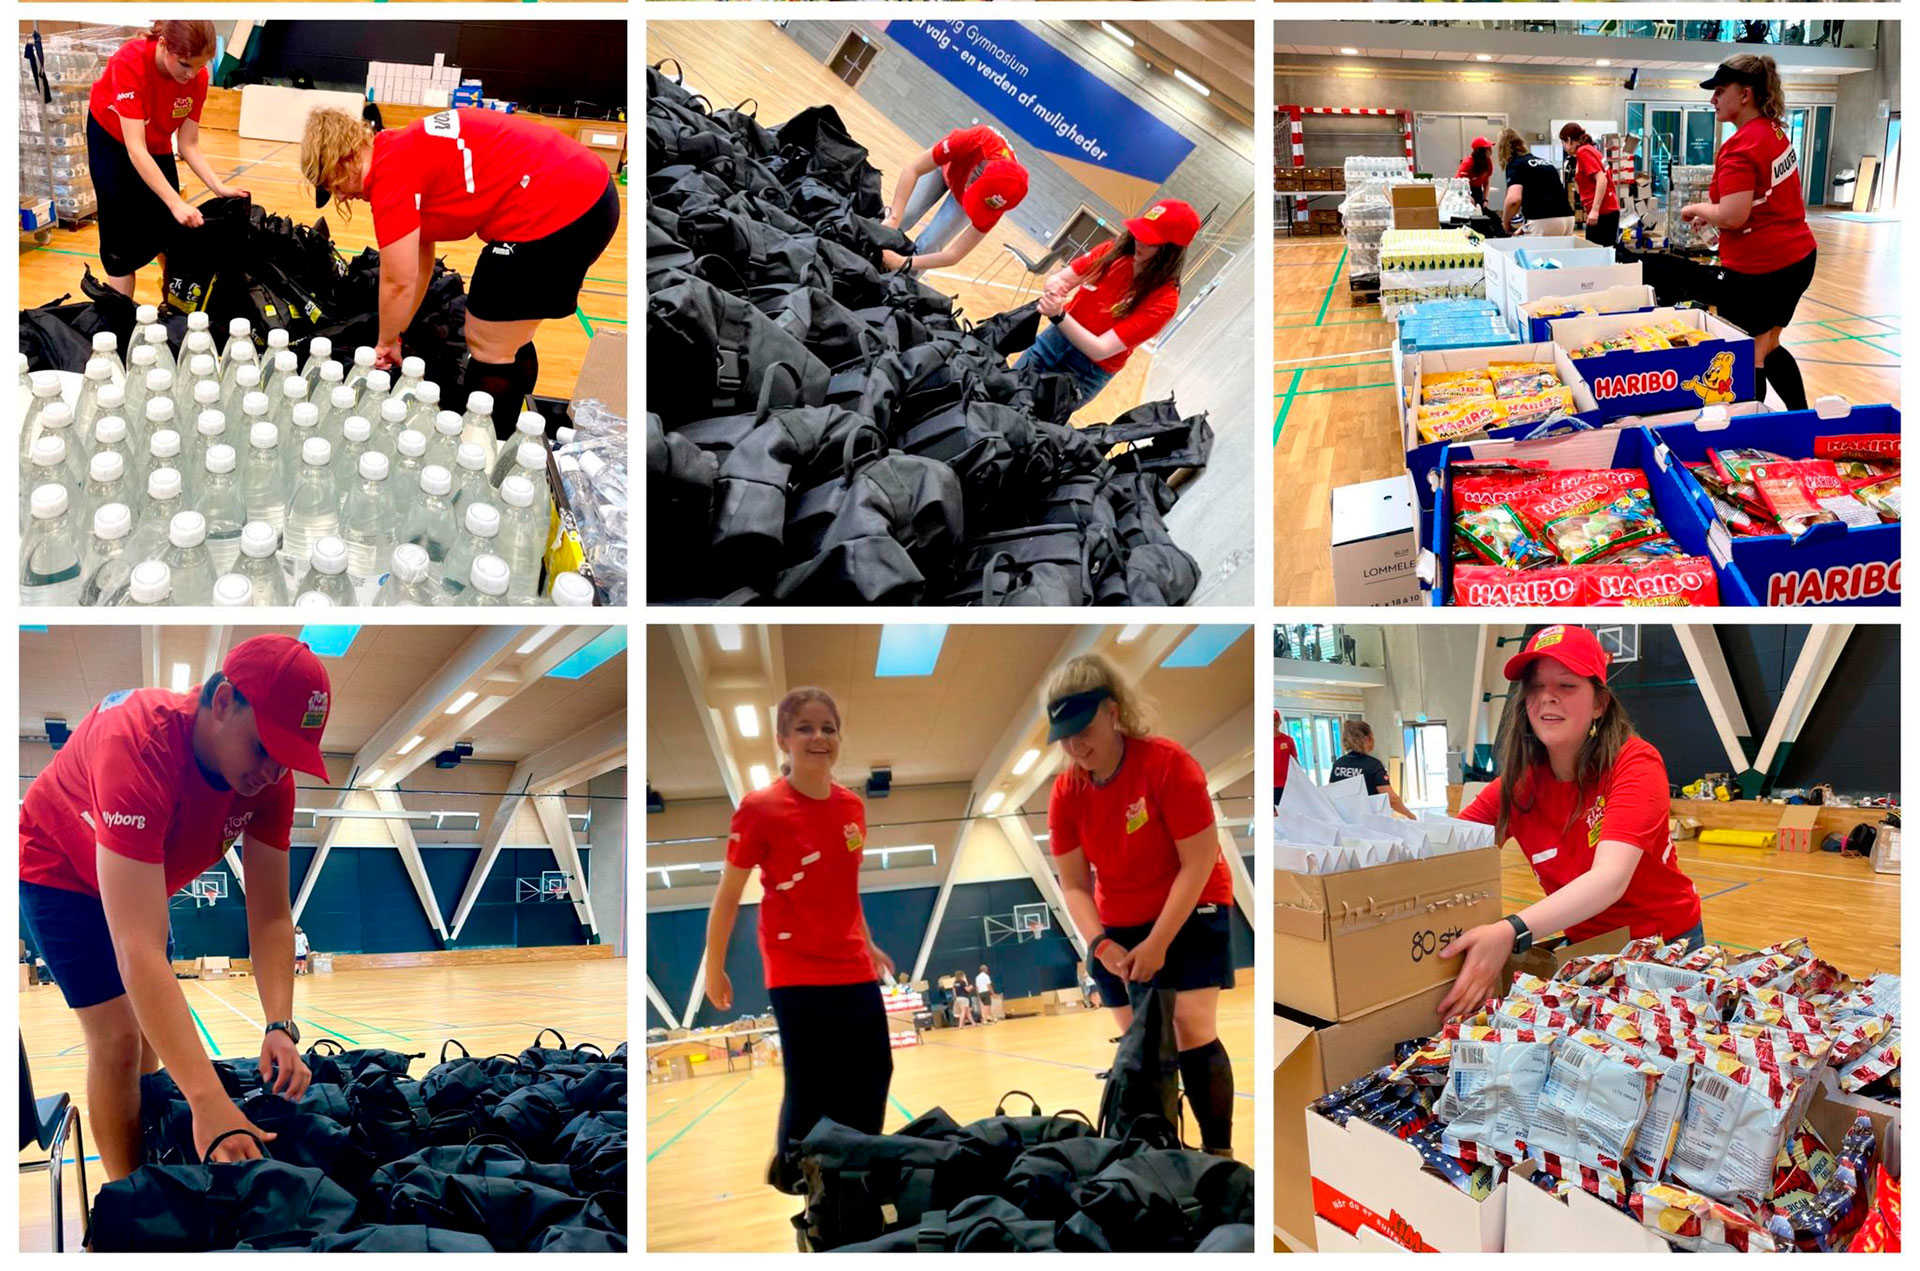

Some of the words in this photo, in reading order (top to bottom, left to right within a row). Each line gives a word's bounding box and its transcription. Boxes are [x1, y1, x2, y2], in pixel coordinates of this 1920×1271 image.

[966, 25, 1029, 78] Gymnasium
[926, 25, 951, 50] valg
[960, 48, 976, 67] en
[977, 61, 1018, 98] verden
[1018, 91, 1035, 109] af
[1033, 102, 1108, 162] muligheder
[1594, 369, 1678, 400] HARIBO
[1432, 407, 1494, 433] HARIBO
[1363, 560, 1416, 578] LOMMELE
[1469, 577, 1575, 605] HARIBO
[1599, 571, 1703, 598] HARIBO
[1334, 767, 1363, 777] CREW
[1411, 930, 1436, 962] 80
